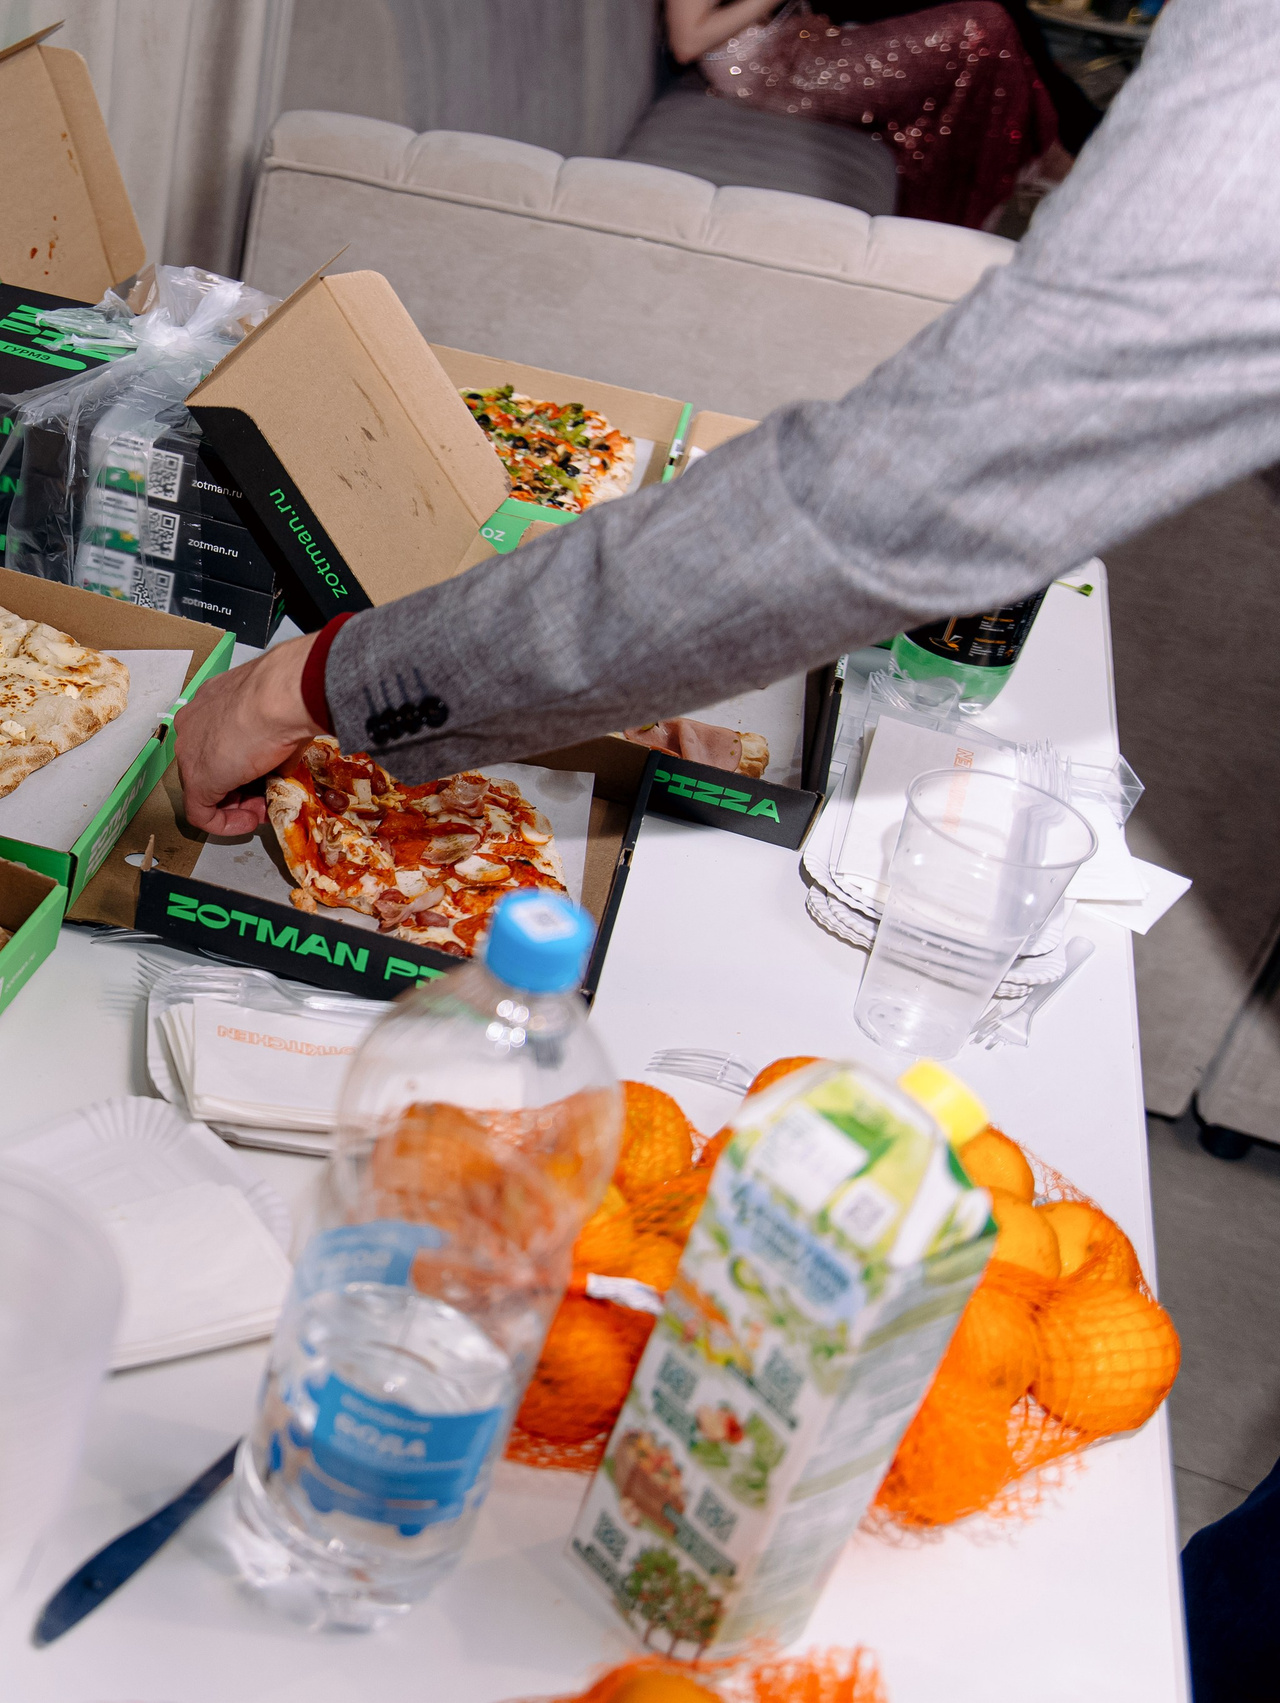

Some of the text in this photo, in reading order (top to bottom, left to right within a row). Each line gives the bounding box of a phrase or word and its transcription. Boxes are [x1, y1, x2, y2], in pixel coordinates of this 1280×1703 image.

[3, 344, 51, 361] ГУРМЭ
[191, 478, 243, 498] zotman.ru
[187, 538, 239, 558] zotman.ru
[269, 488, 349, 599] zotman.ru
[182, 595, 232, 616] zotman.ru
[165, 892, 370, 974] ZOTMAN
[216, 1025, 358, 1056] OTKITCHEN
